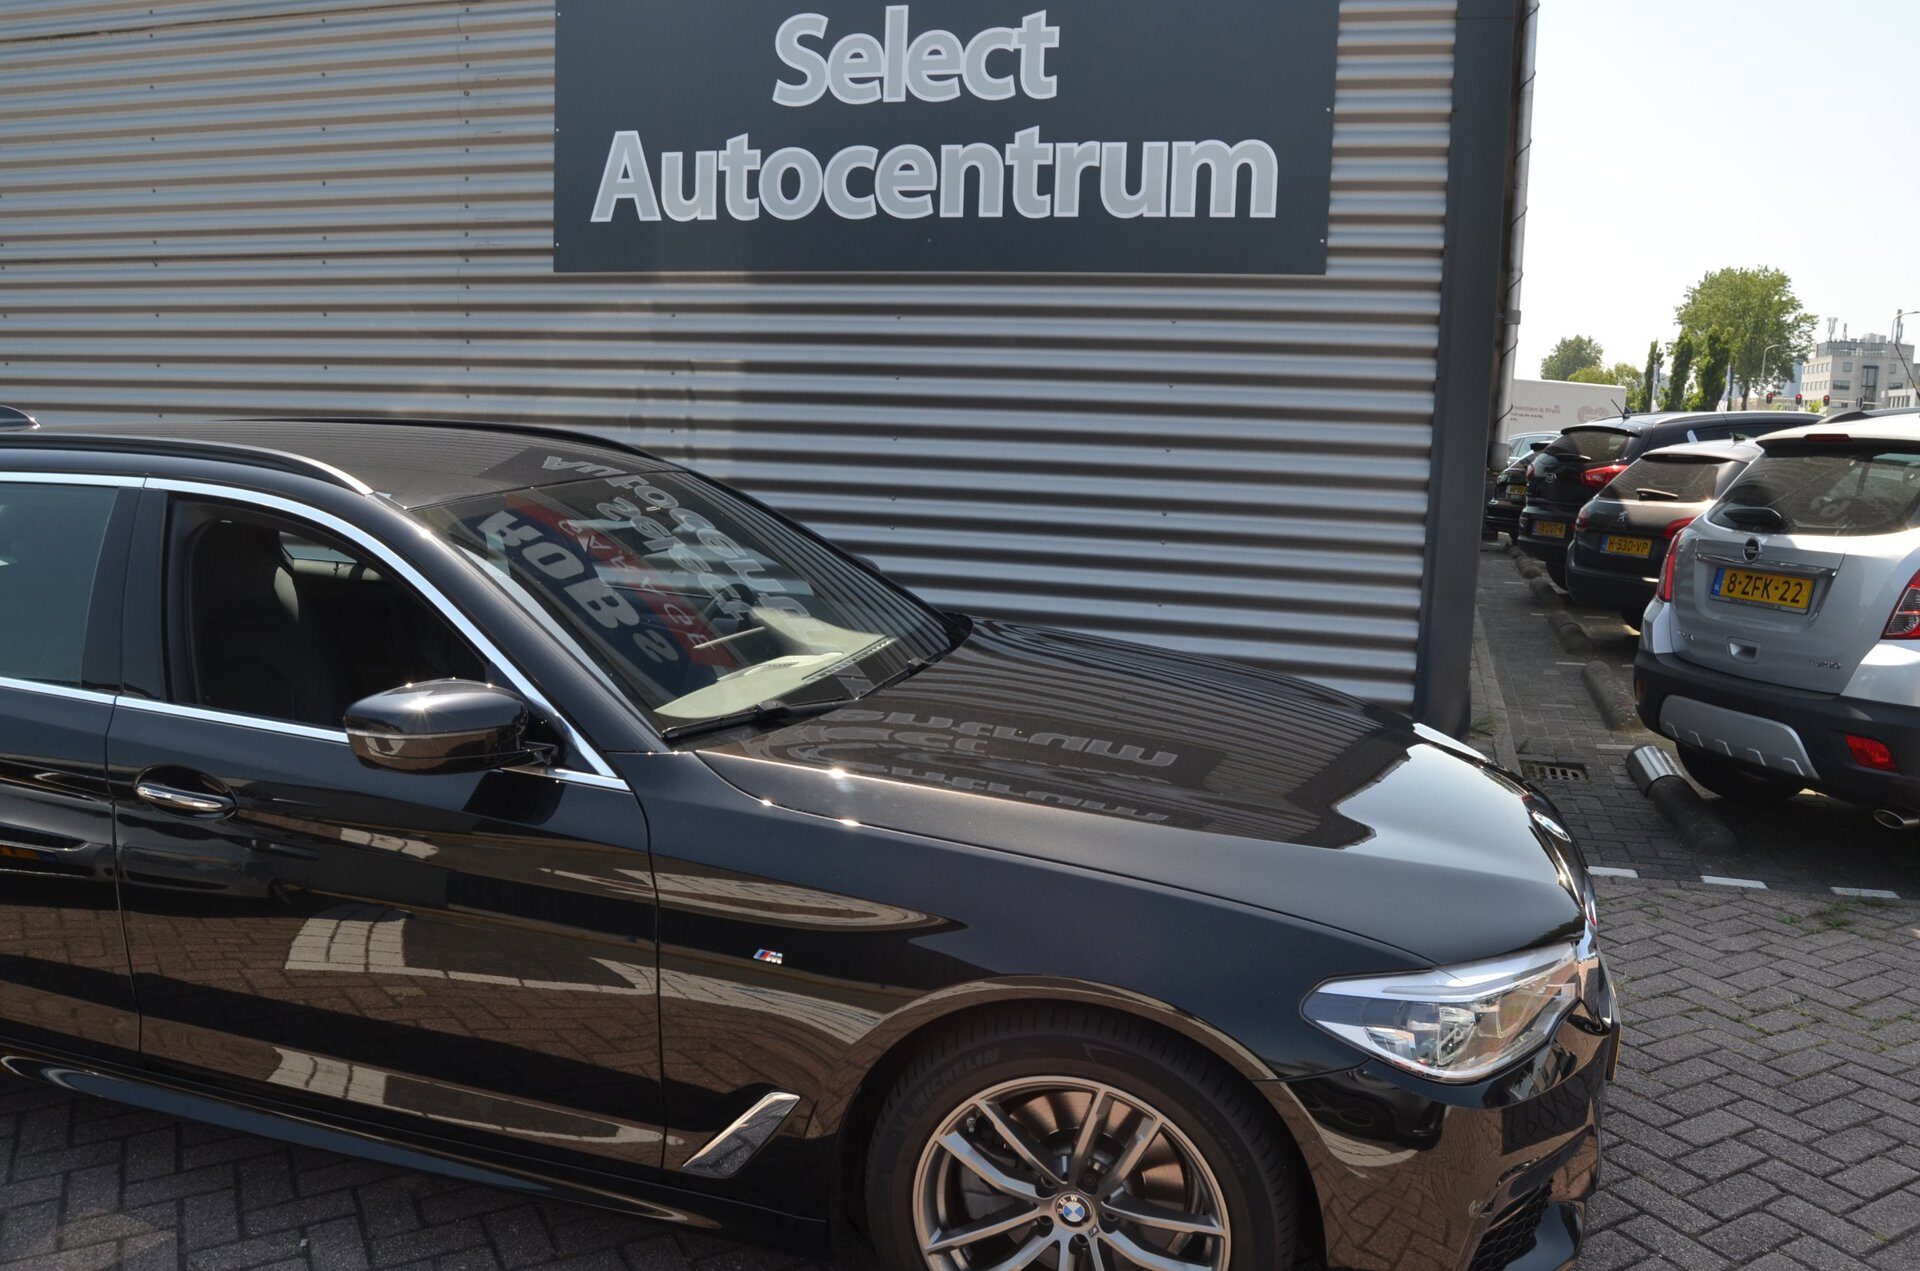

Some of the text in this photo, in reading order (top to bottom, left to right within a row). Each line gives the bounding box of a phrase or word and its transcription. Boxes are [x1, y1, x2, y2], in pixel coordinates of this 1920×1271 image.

[772, 5, 1060, 107] Select
[590, 125, 1278, 223] Autocentrum
[1726, 573, 1803, 604] 8-ZFK-22
